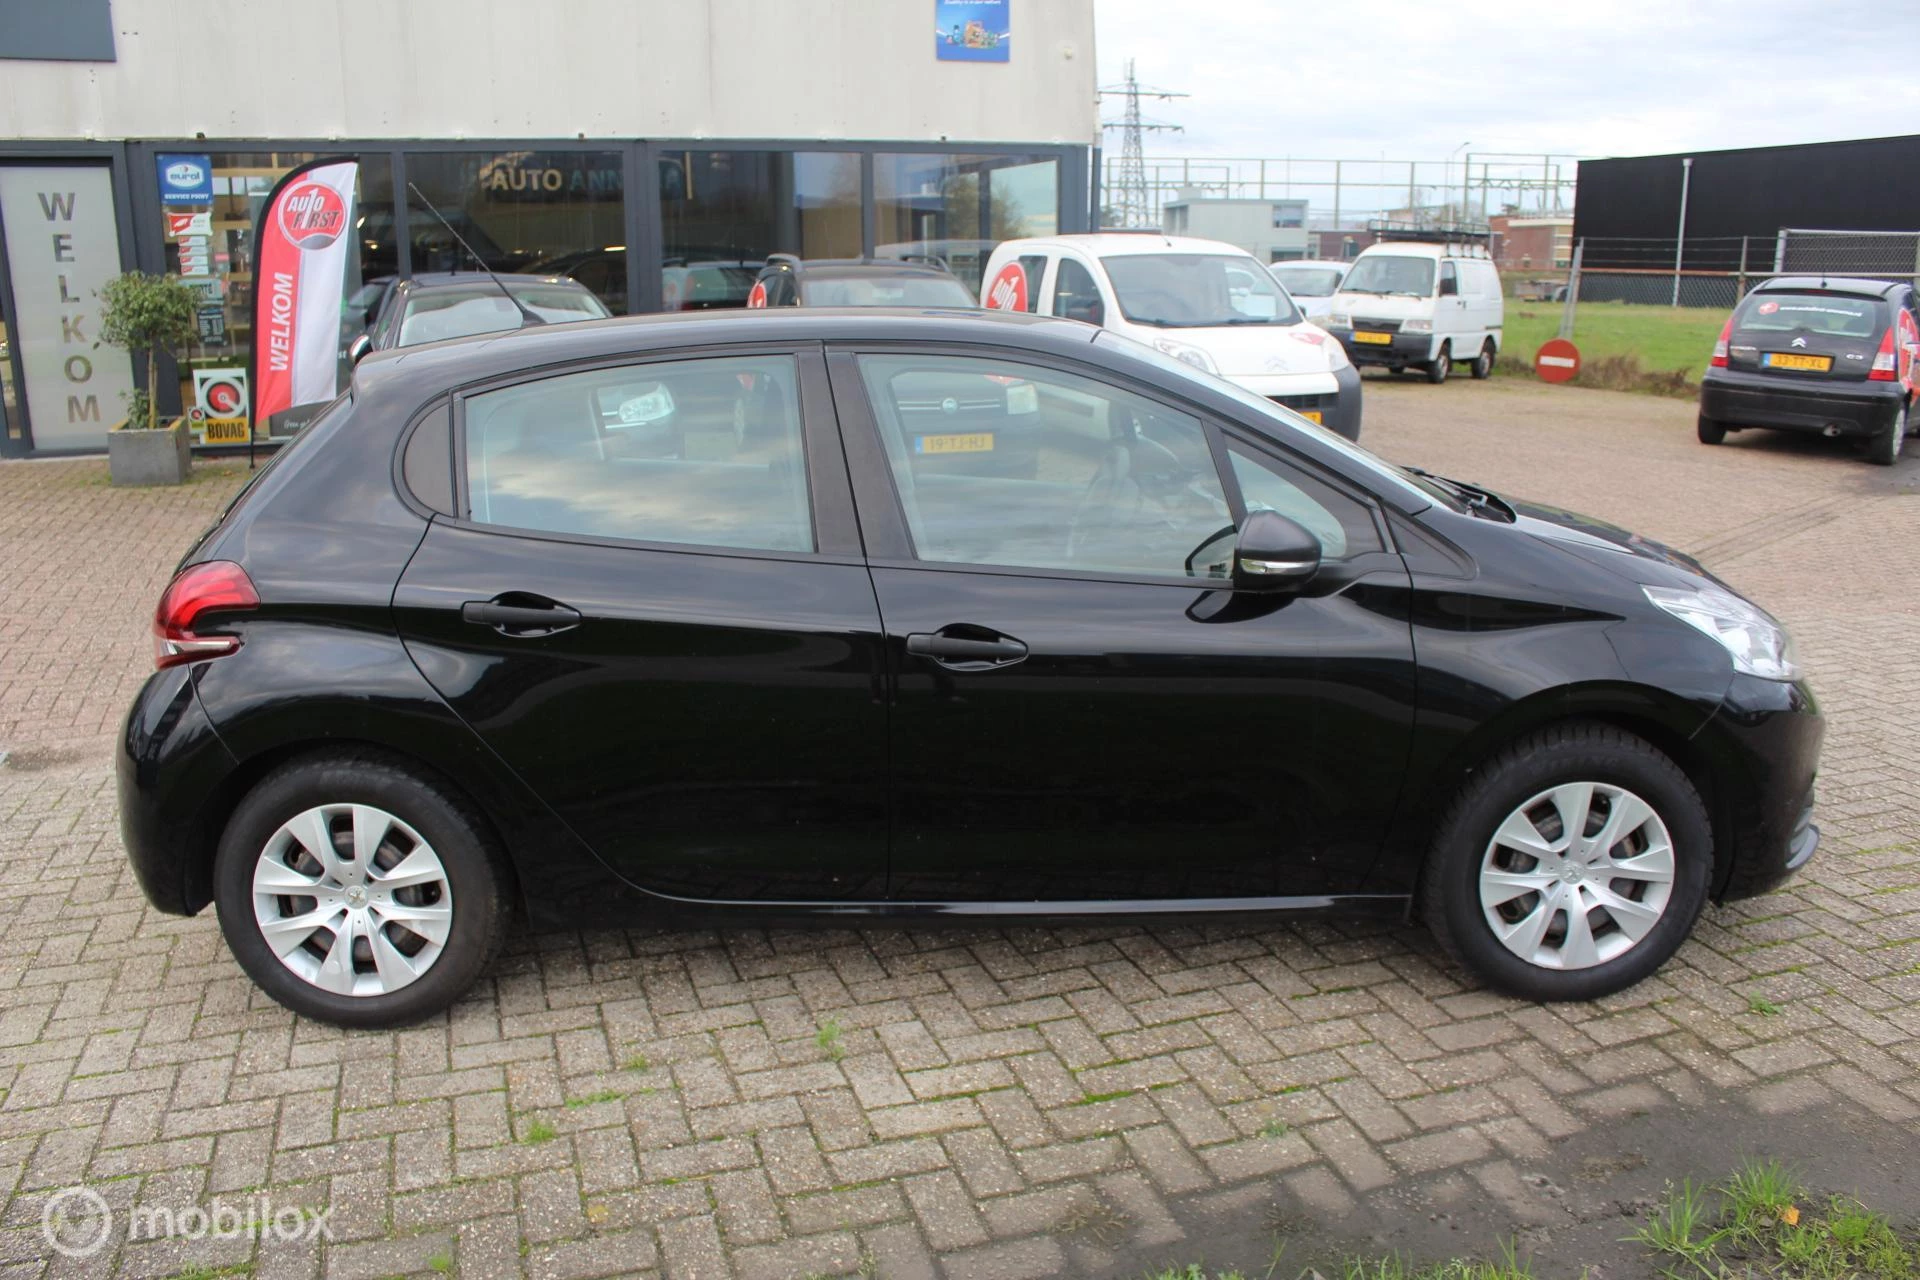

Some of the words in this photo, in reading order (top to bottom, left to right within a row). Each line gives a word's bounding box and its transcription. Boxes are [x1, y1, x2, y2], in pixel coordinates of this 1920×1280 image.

[170, 172, 200, 180] eurol
[491, 168, 563, 191] AUTO
[36, 192, 101, 423] WELKOM
[270, 272, 293, 371] WELKOM
[208, 421, 245, 440] BOVAG
